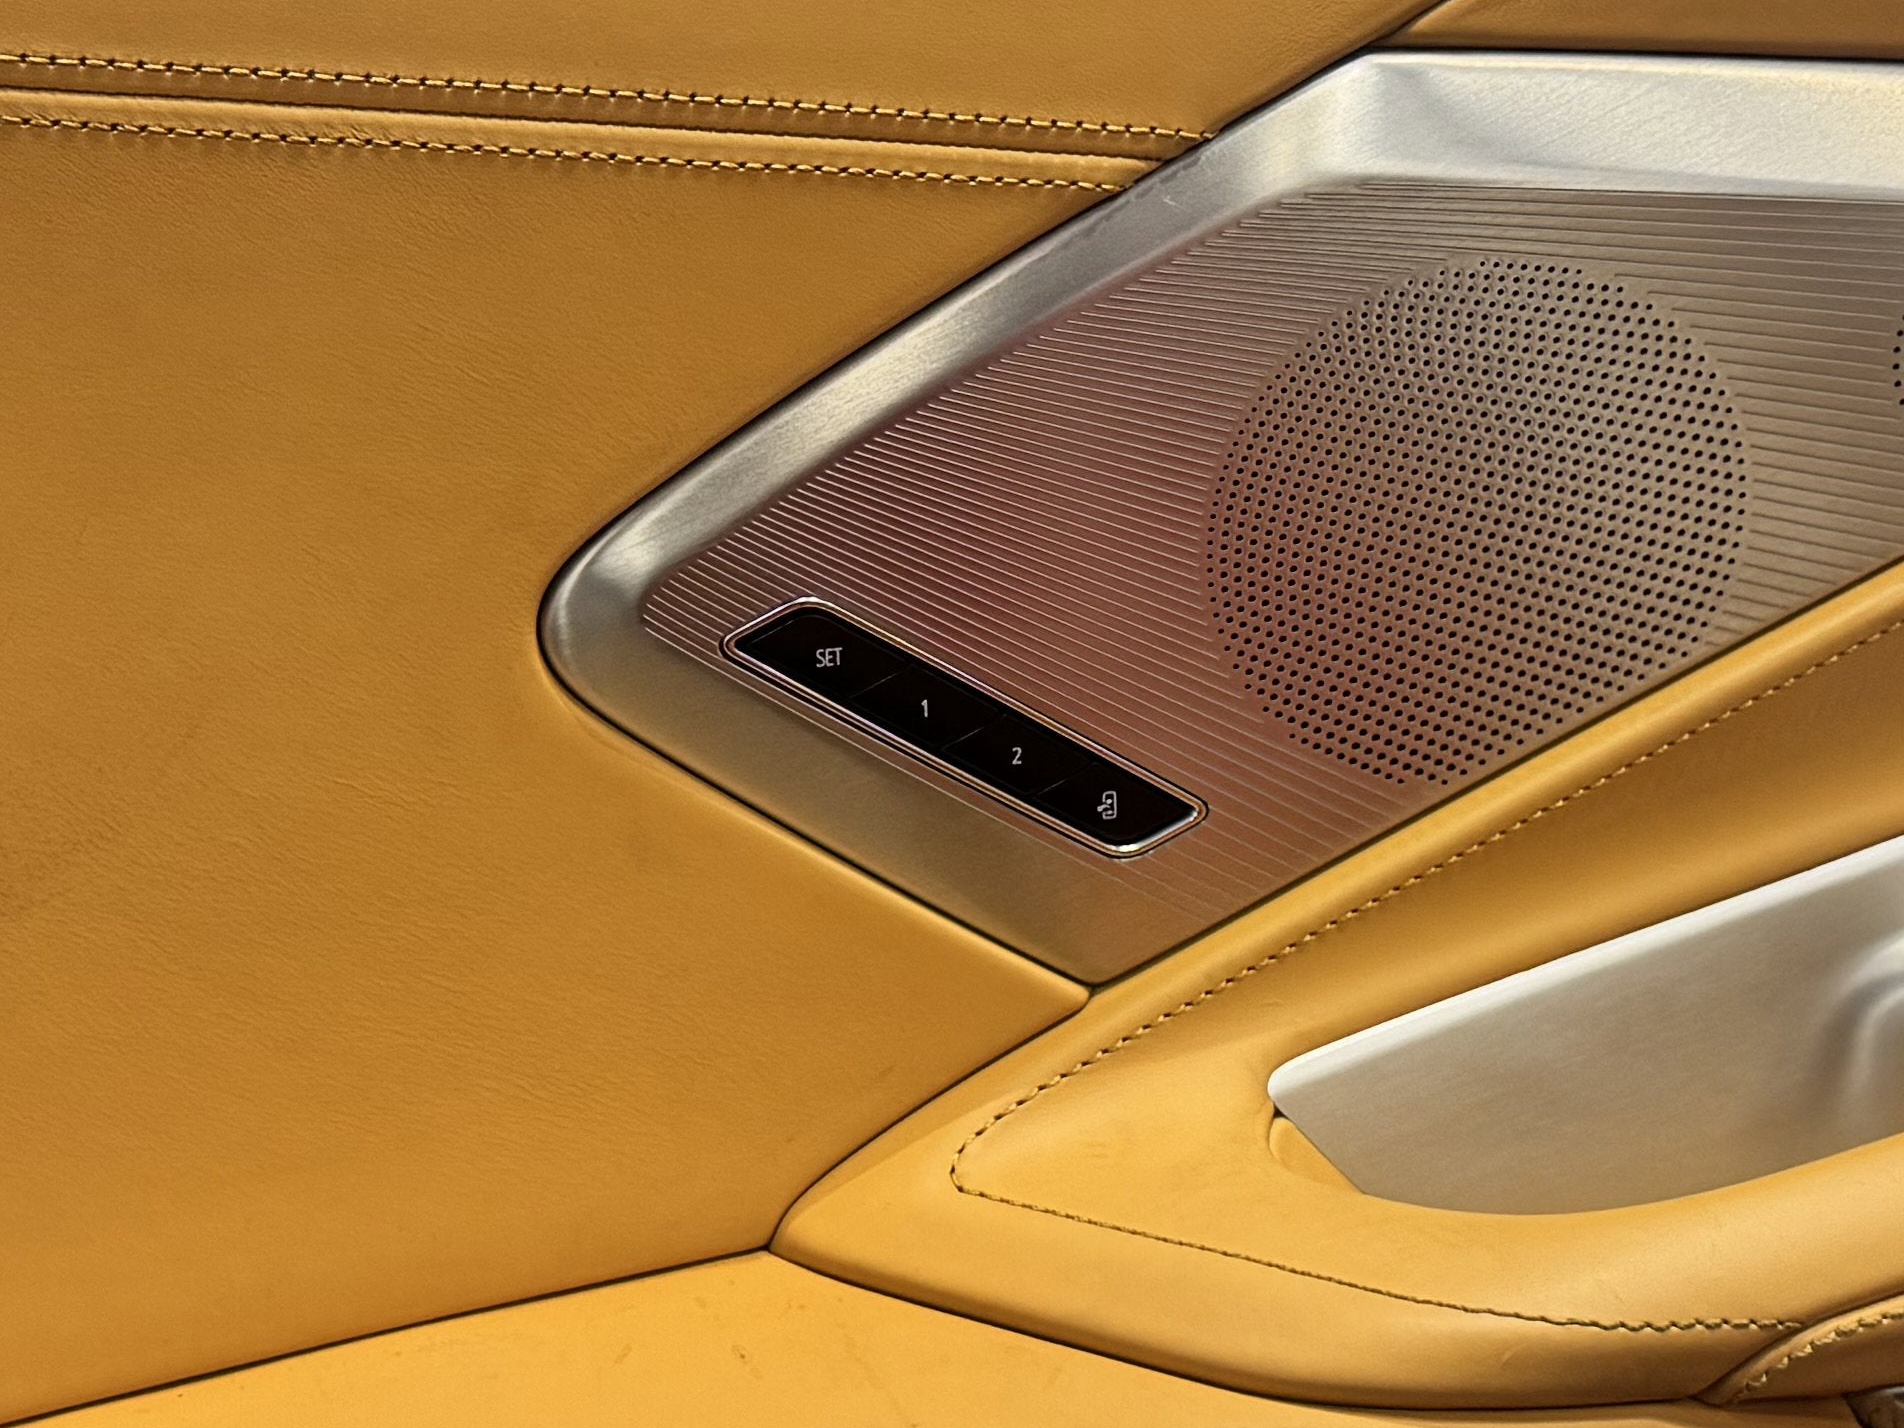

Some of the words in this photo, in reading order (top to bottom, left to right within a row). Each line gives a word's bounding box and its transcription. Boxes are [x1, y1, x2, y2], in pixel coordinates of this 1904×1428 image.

[816, 647, 843, 668] SET
[920, 699, 929, 718] 1
[1011, 746, 1023, 765] 2
